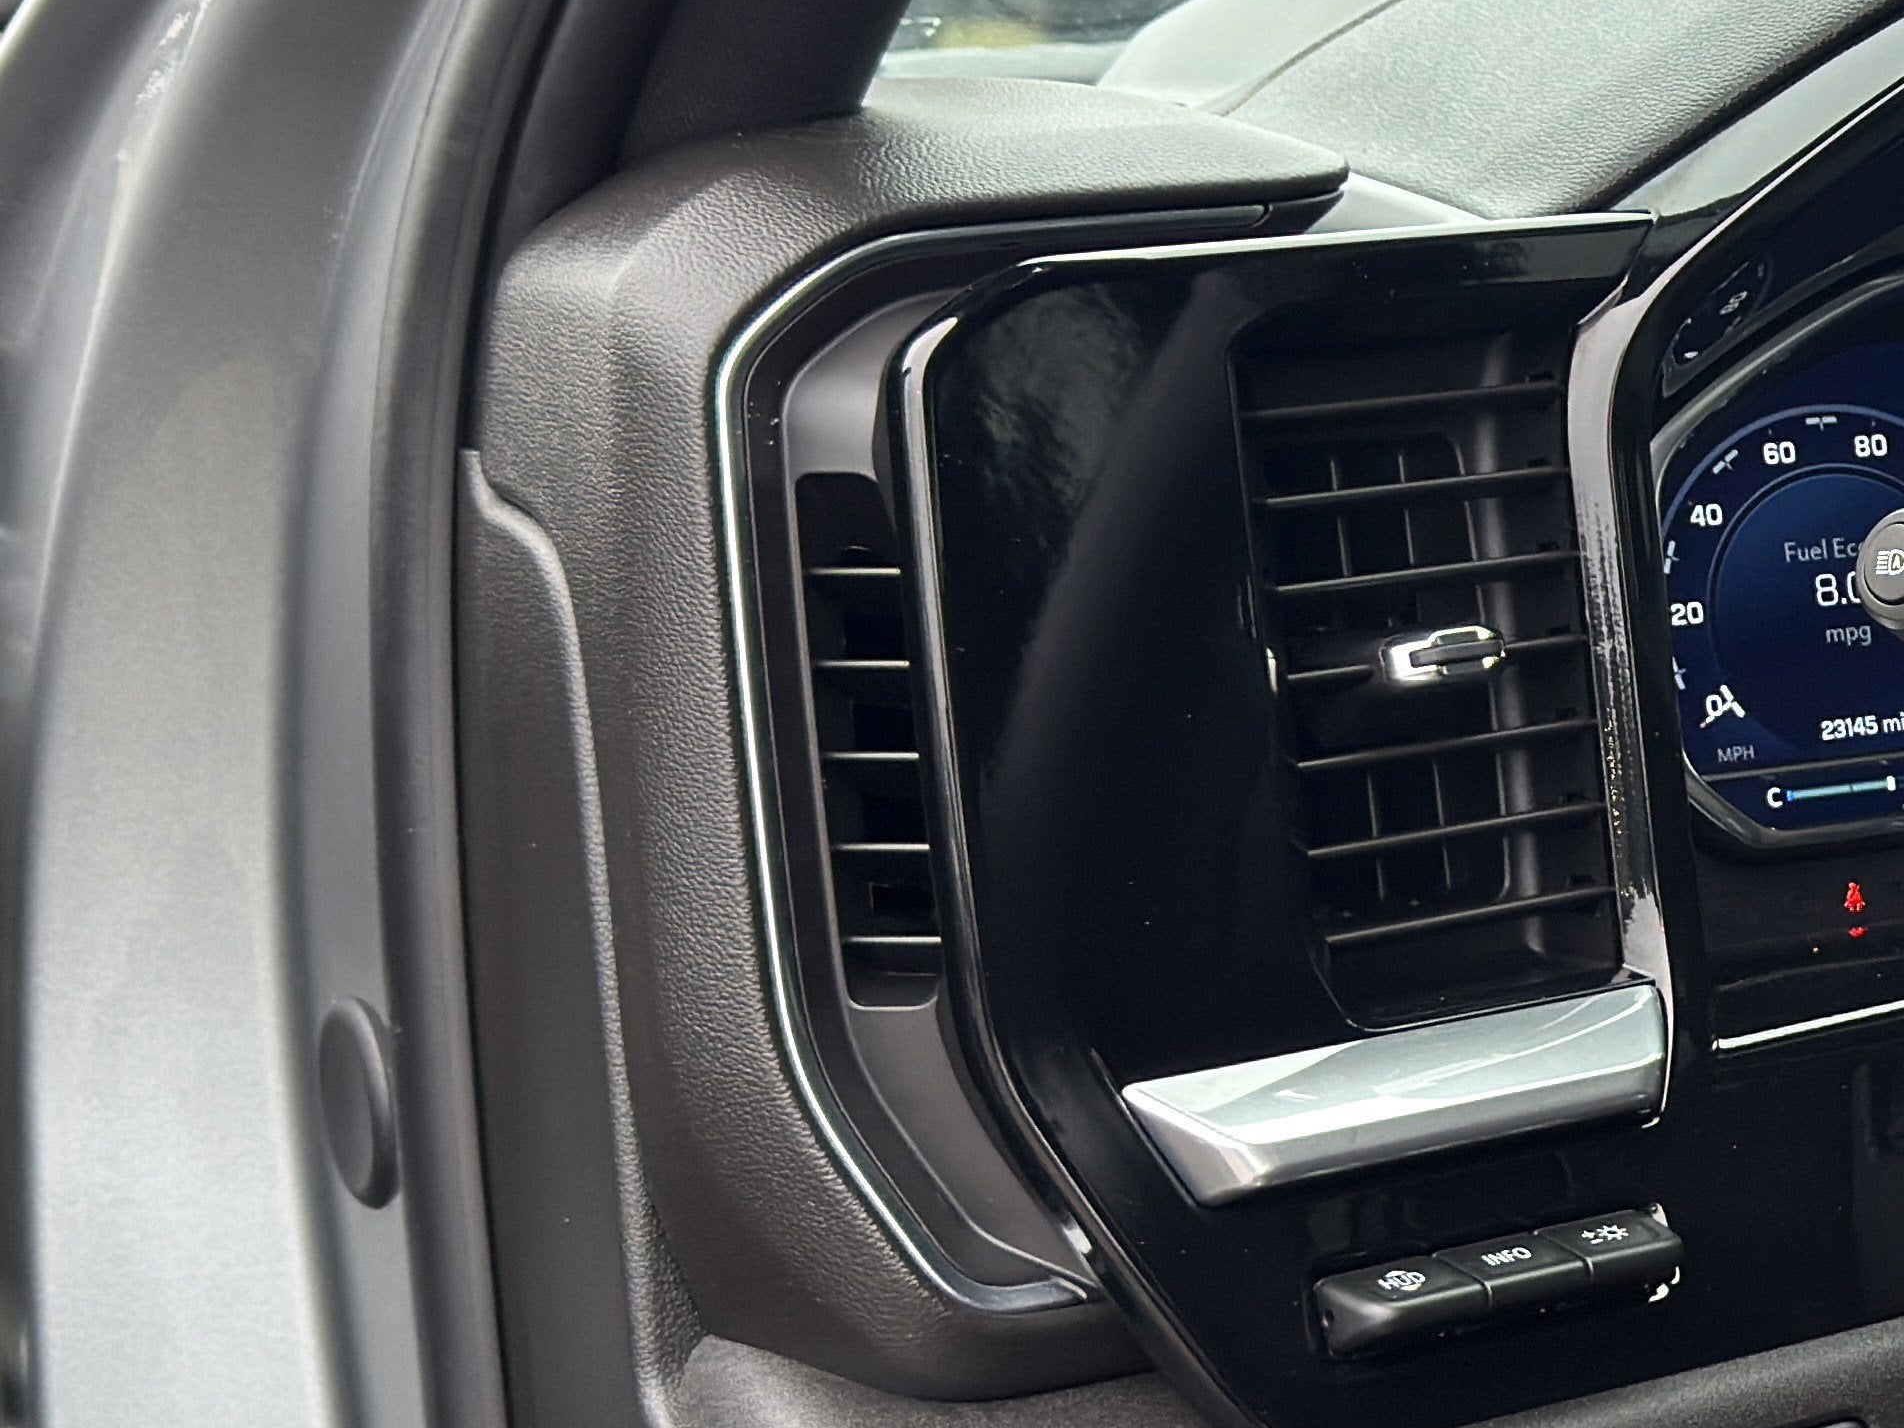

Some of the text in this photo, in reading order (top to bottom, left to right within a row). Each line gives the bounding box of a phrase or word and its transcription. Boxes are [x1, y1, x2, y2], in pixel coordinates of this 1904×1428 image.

[1763, 441, 1796, 465] 60
[1854, 434, 1888, 457] 80
[1690, 503, 1723, 527] 40
[1784, 539, 1828, 563] Fuel
[1670, 601, 1703, 626] 20
[1826, 623, 1872, 646] mpg
[1821, 714, 1878, 741] 23145
[1717, 745, 1755, 763] MPH
[1766, 786, 1785, 808] C
[1481, 1246, 1531, 1267] INFO
[1378, 1270, 1426, 1292] HUD
